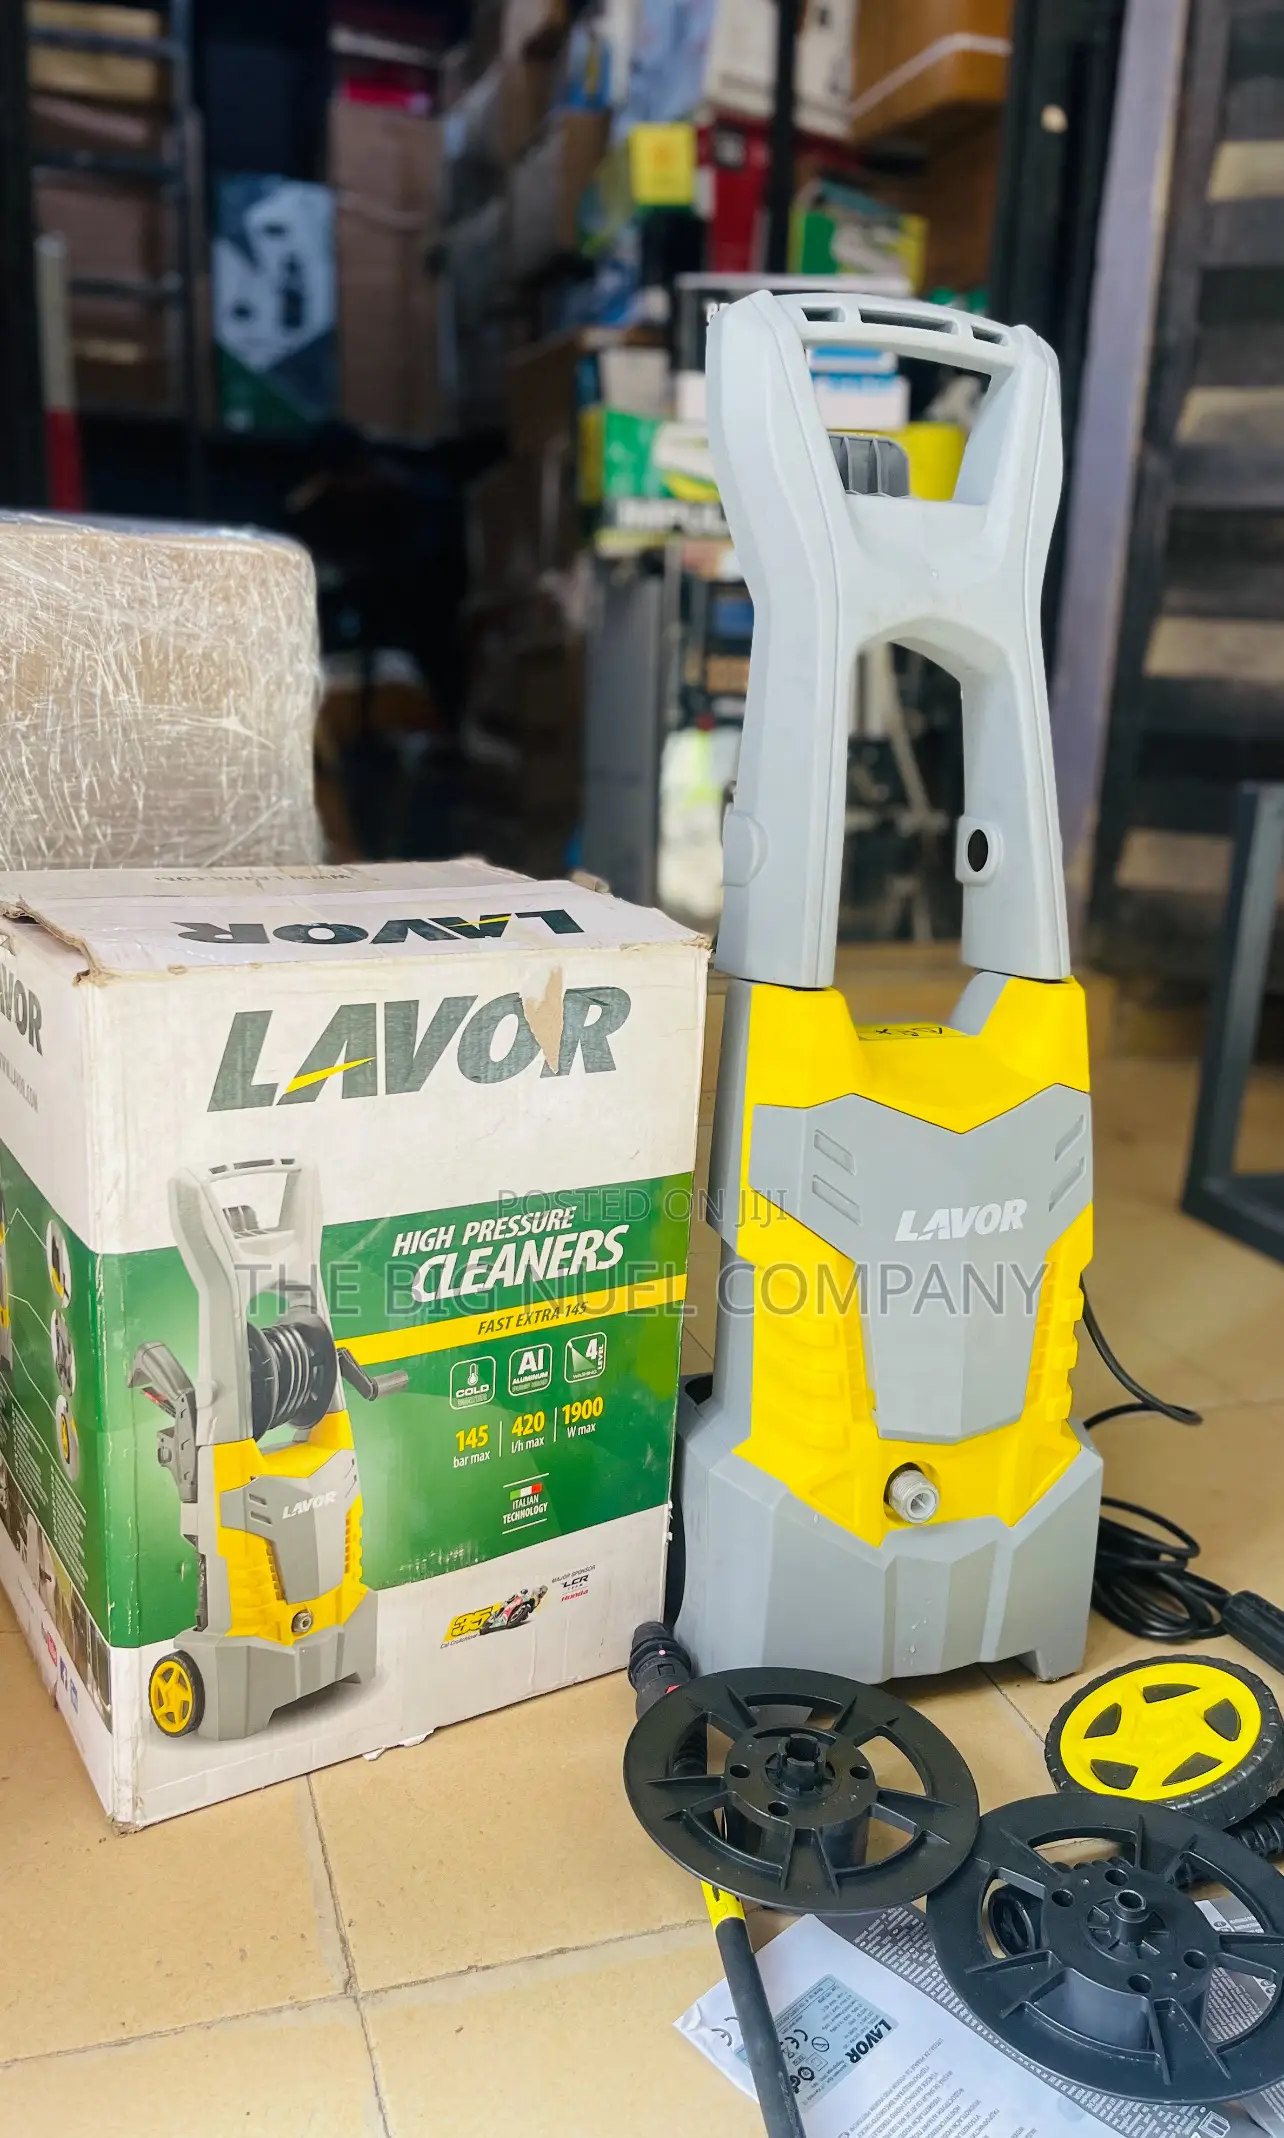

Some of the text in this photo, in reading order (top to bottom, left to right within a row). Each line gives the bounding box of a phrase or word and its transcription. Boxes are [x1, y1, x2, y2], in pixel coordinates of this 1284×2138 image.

[172, 909, 584, 945] LAVOR
[207, 986, 631, 1112] LAVOR
[392, 1206, 577, 1257] HIGH PRESSURE
[894, 1198, 1027, 1242] LAVOR
[412, 1224, 630, 1302] CLEANERS
[478, 1301, 588, 1335] FAST EXTRA 145
[585, 1338, 598, 1360] 4
[455, 1384, 490, 1398] COLD
[512, 1371, 549, 1385] ALUMINUM
[511, 1411, 545, 1437] 420
[562, 1396, 604, 1425] 1900
[455, 1425, 489, 1452] 145
[525, 1437, 545, 1450] max
[567, 1423, 596, 1438] W max
[453, 1451, 491, 1468] bar max
[282, 1490, 338, 1519] LAVOR
[503, 1502, 549, 1524] TECHNOLOGY
[512, 1494, 539, 1510] ITALIAN
[845, 2018, 892, 2064] LAVOR
